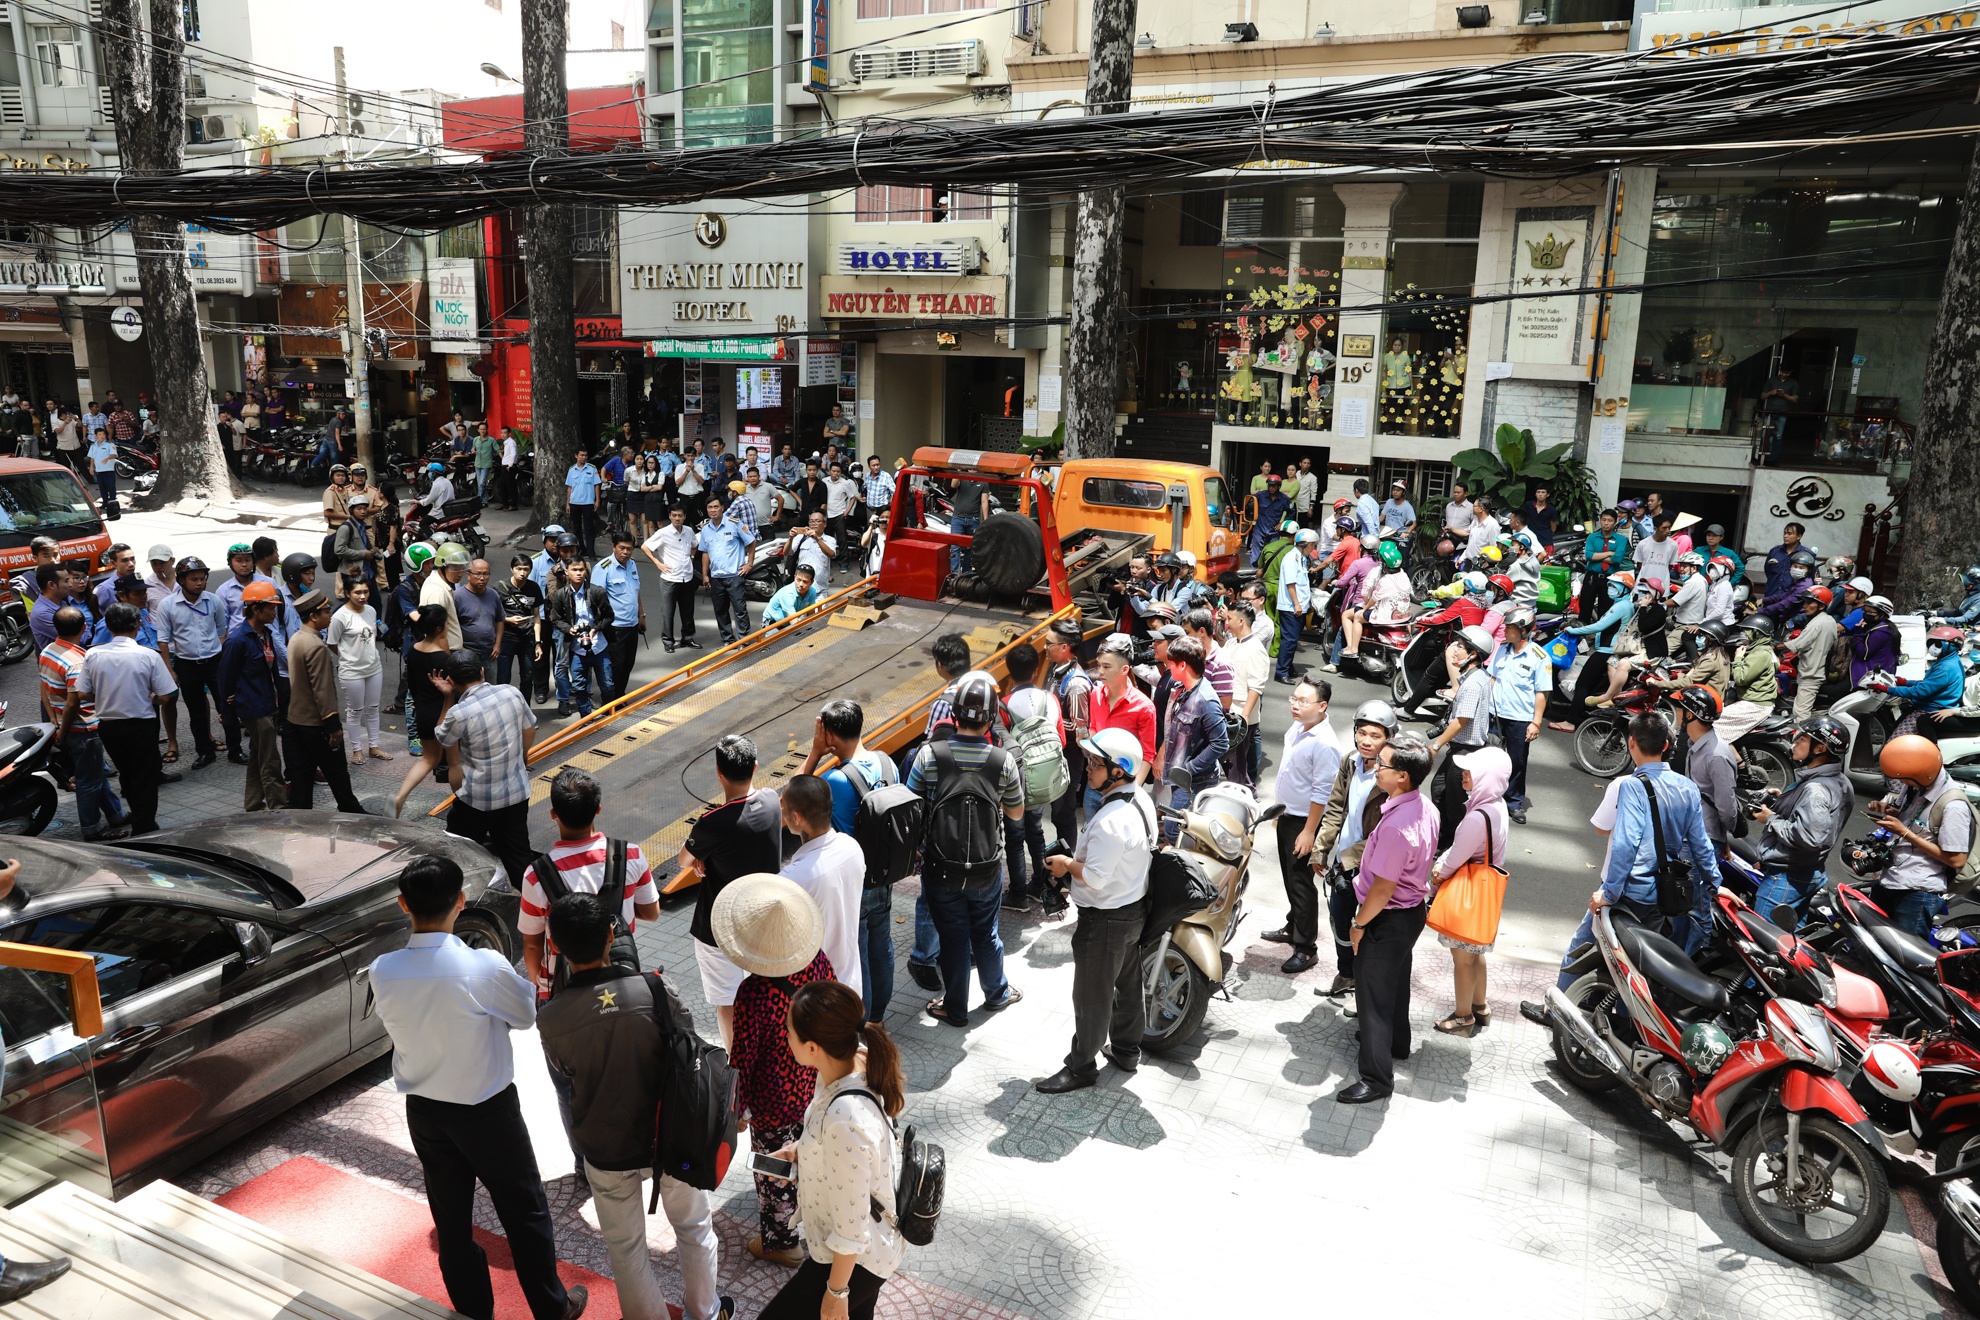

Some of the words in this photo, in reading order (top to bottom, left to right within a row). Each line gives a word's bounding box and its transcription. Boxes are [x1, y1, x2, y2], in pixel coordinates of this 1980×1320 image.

[850, 251, 949, 270] HOTEL
[26, 262, 68, 285] STAR
[625, 262, 723, 290] THANH
[729, 261, 803, 290] MINH
[827, 287, 911, 314] NGUYÊN
[916, 292, 996, 315] THANH
[672, 301, 753, 322] HOTEL
[652, 339, 675, 354] Special
[9, 554, 26, 566] DỊCH
[60, 546, 77, 557] CÔNG
[77, 544, 87, 553] ÍCH
[1945, 566, 1960, 577] 17
